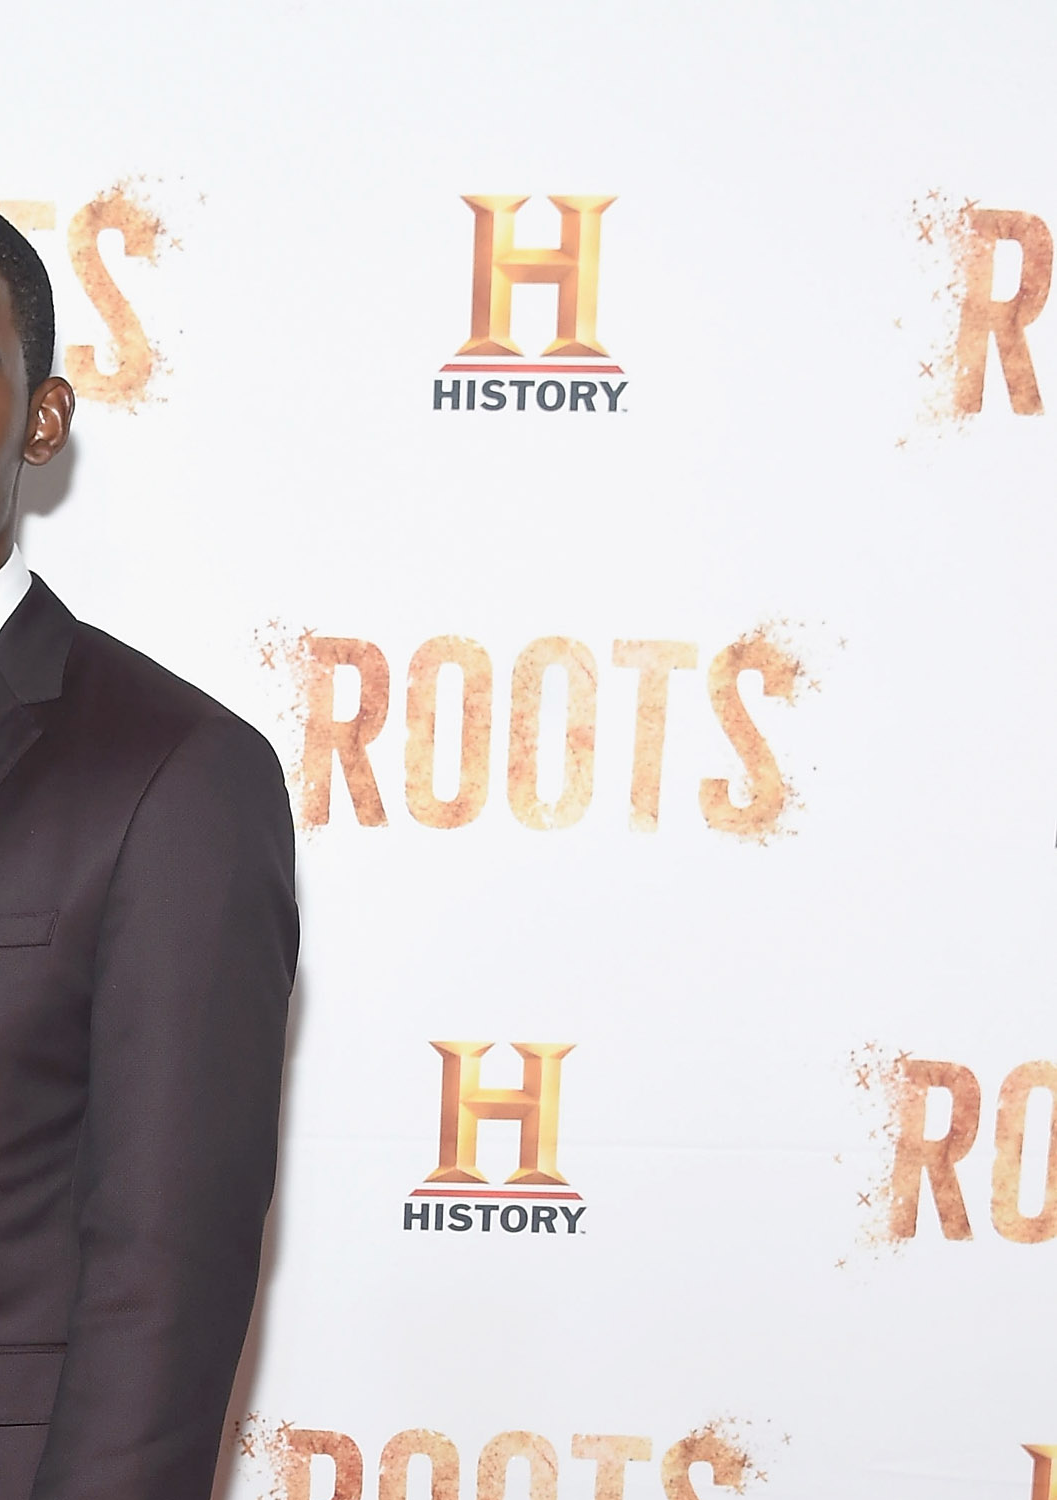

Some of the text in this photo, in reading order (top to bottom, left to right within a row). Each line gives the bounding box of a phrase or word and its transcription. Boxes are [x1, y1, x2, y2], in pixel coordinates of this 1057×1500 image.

[455, 194, 618, 358] H
[433, 379, 629, 412] HISTORY
[300, 632, 798, 838] ROOTS
[425, 1040, 576, 1186] H
[403, 1202, 587, 1234] HISTORY
